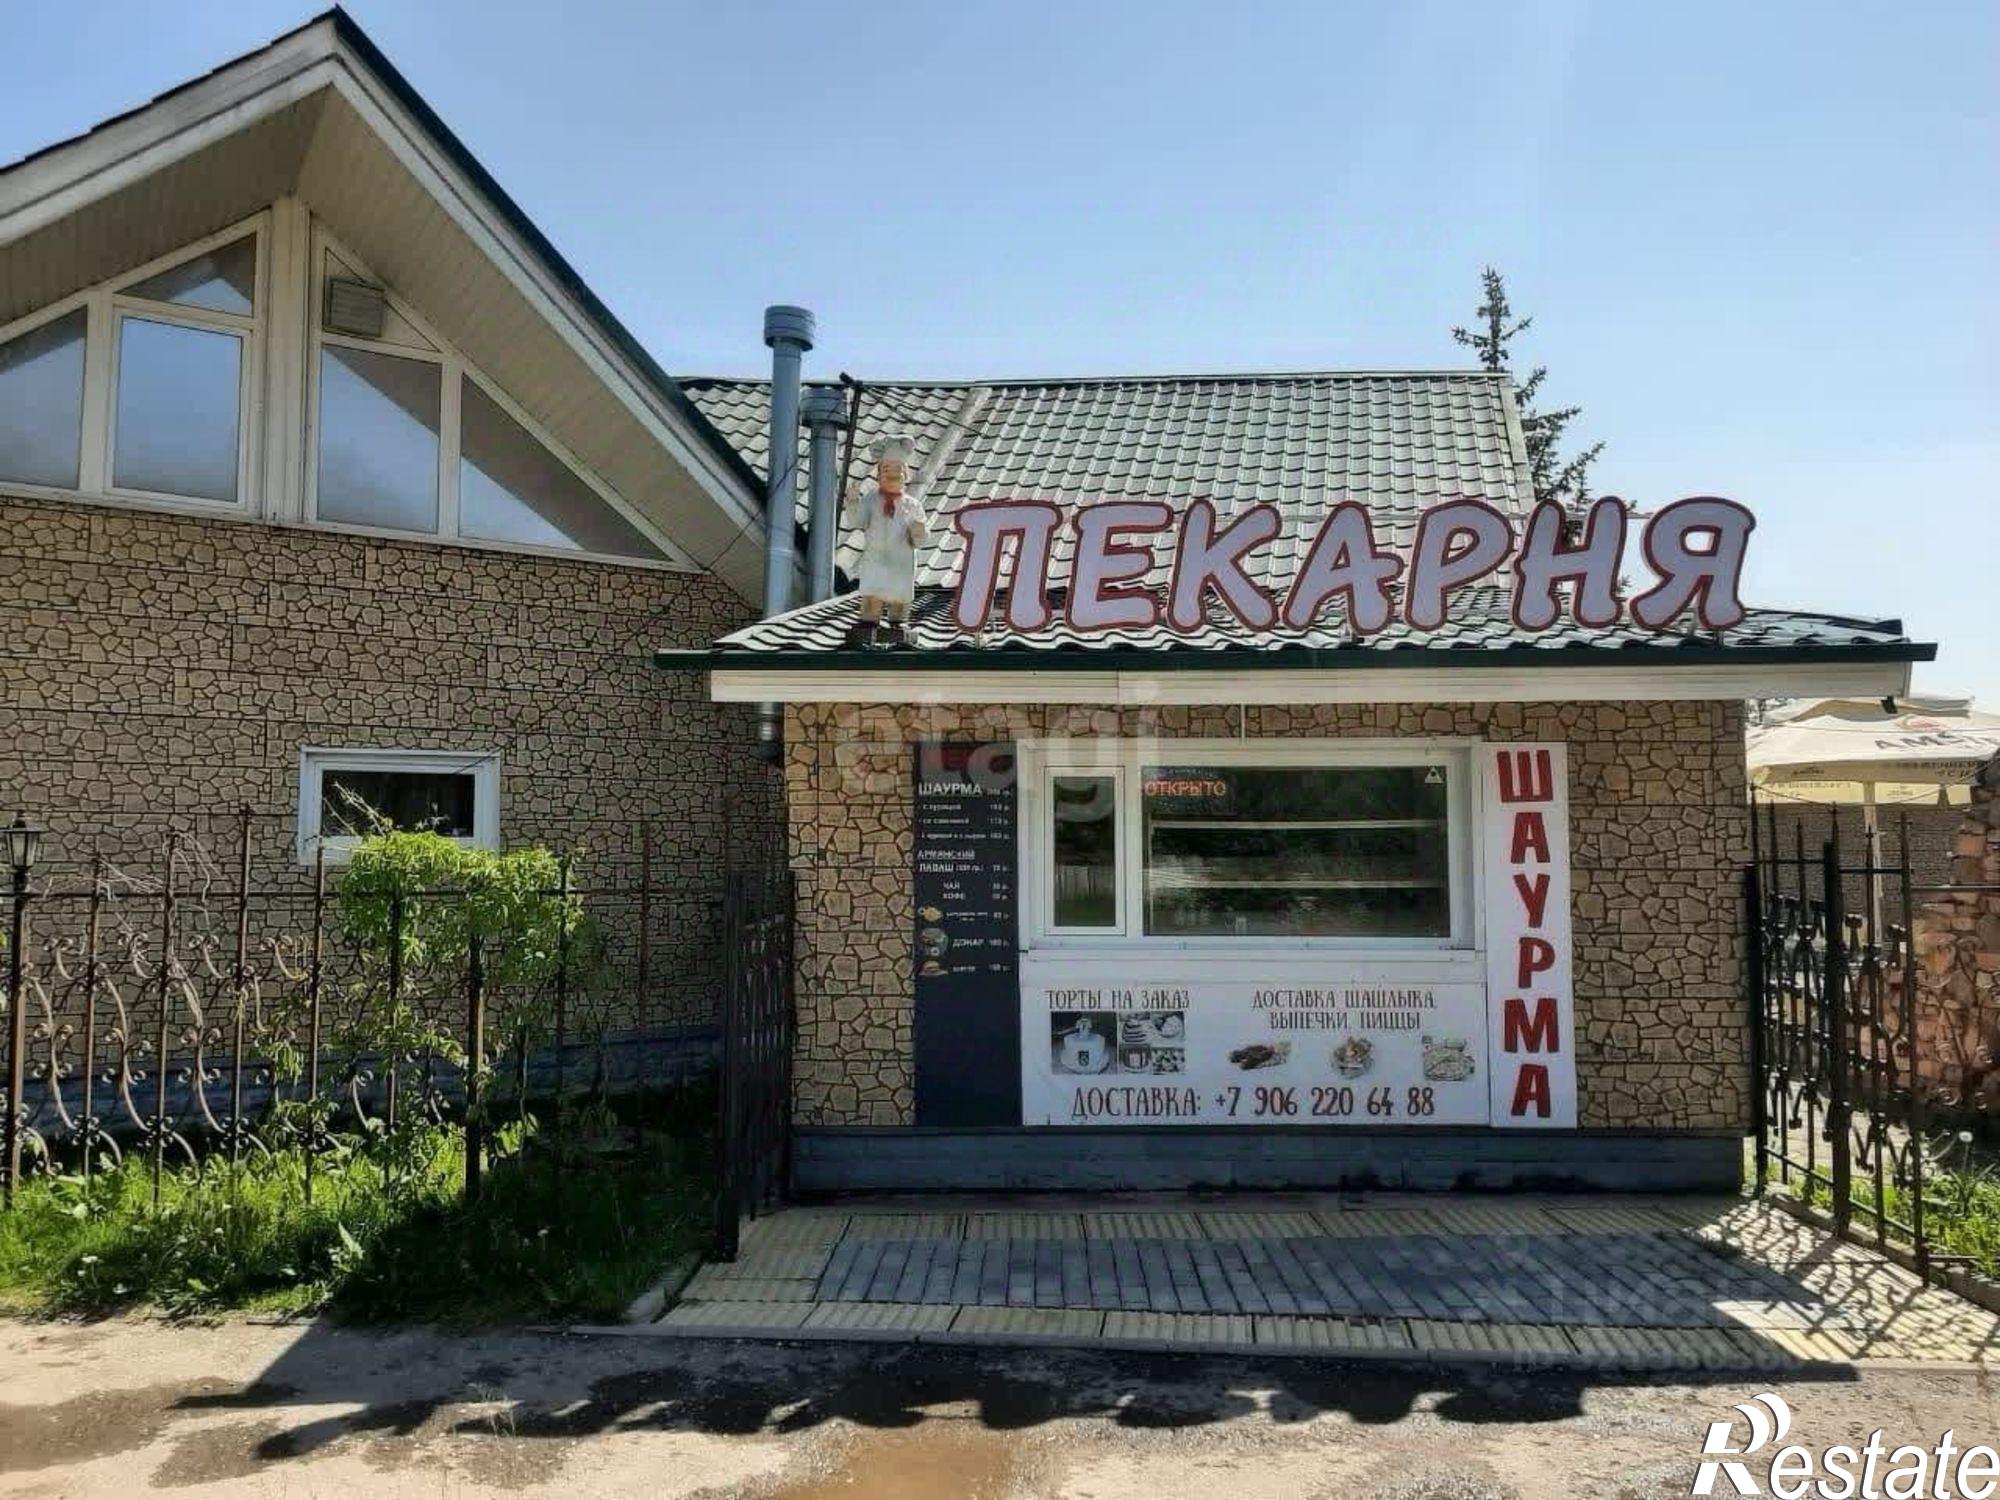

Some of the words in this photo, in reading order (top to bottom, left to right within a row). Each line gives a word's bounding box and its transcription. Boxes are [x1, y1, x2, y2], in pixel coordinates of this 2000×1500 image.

[952, 496, 1757, 633] ПЕКАРНЯ
[918, 783, 982, 797] ШАУРМА
[1144, 779, 1228, 797] ОТКРЫТО
[1497, 749, 1561, 1118] ШАУРМА
[1047, 990, 1101, 1009] ТОРТЫ
[1111, 990, 1133, 1008] НА
[1141, 990, 1190, 1008] ЗАКАЗ
[1252, 990, 1336, 1008] ДОСТАВКА
[1345, 990, 1436, 1008] ШАШЛЫКА
[1270, 1012, 1348, 1030] ВЫПЕЧКИ
[1360, 1012, 1420, 1031] ПИЦЦЫ
[1072, 1087, 1201, 1120] ДОСТАВКА:
[1215, 1087, 1242, 1117] +7
[1254, 1087, 1299, 1117] 906
[1310, 1087, 1354, 1117] 220
[1367, 1087, 1394, 1117] 64
[1407, 1087, 1435, 1117] 88
